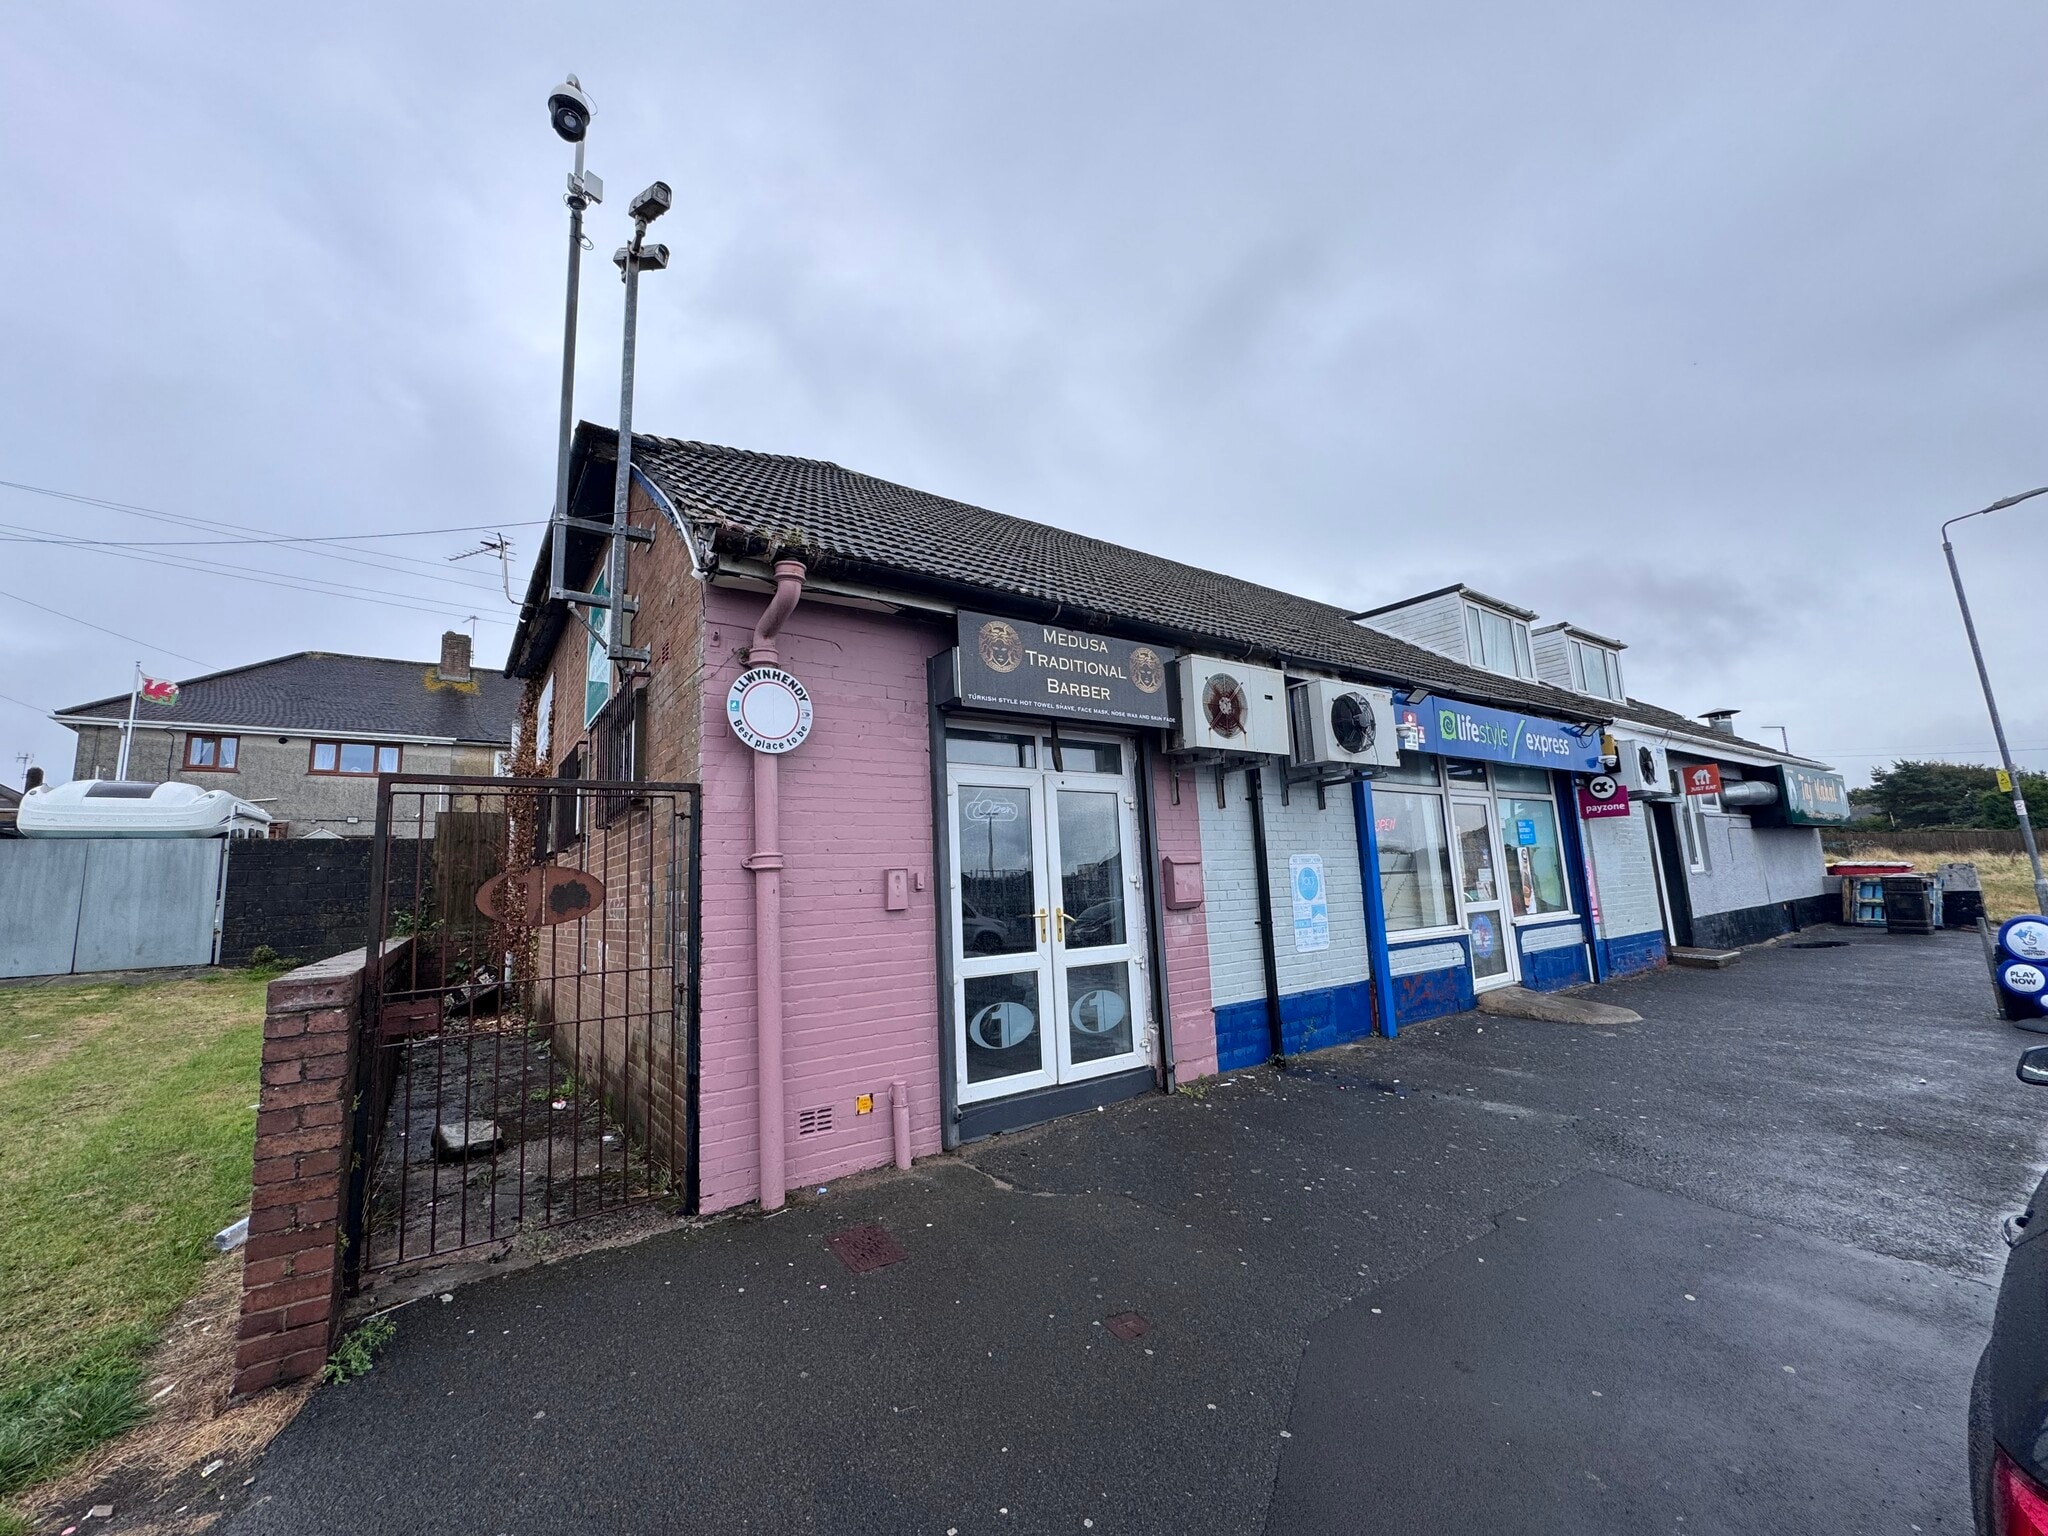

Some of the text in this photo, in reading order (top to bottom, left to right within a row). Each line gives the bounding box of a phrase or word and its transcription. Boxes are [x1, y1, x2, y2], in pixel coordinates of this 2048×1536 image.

[1042, 628, 1109, 654] MEDUSA
[1024, 649, 1127, 680] TRADITIONAL
[733, 669, 809, 702] LLWYNHENDY
[1046, 678, 1111, 701] BARBER
[967, 693, 997, 703] TURKISH
[998, 697, 1018, 705] STYLE
[1033, 701, 1055, 709] TOWEL
[1055, 703, 1077, 712] SHAVE,
[1077, 706, 1092, 714] FACE
[733, 719, 808, 750] Best place to be
[1456, 713, 1509, 751] lifestyle
[1525, 732, 1570, 758] express
[1690, 785, 1705, 793] JUST
[973, 799, 1015, 819] Open
[1585, 803, 1626, 814] payzone
[1376, 817, 1396, 832] OPEN
[2010, 970, 2036, 978] PLAY
[2011, 977, 2036, 985] NOW
